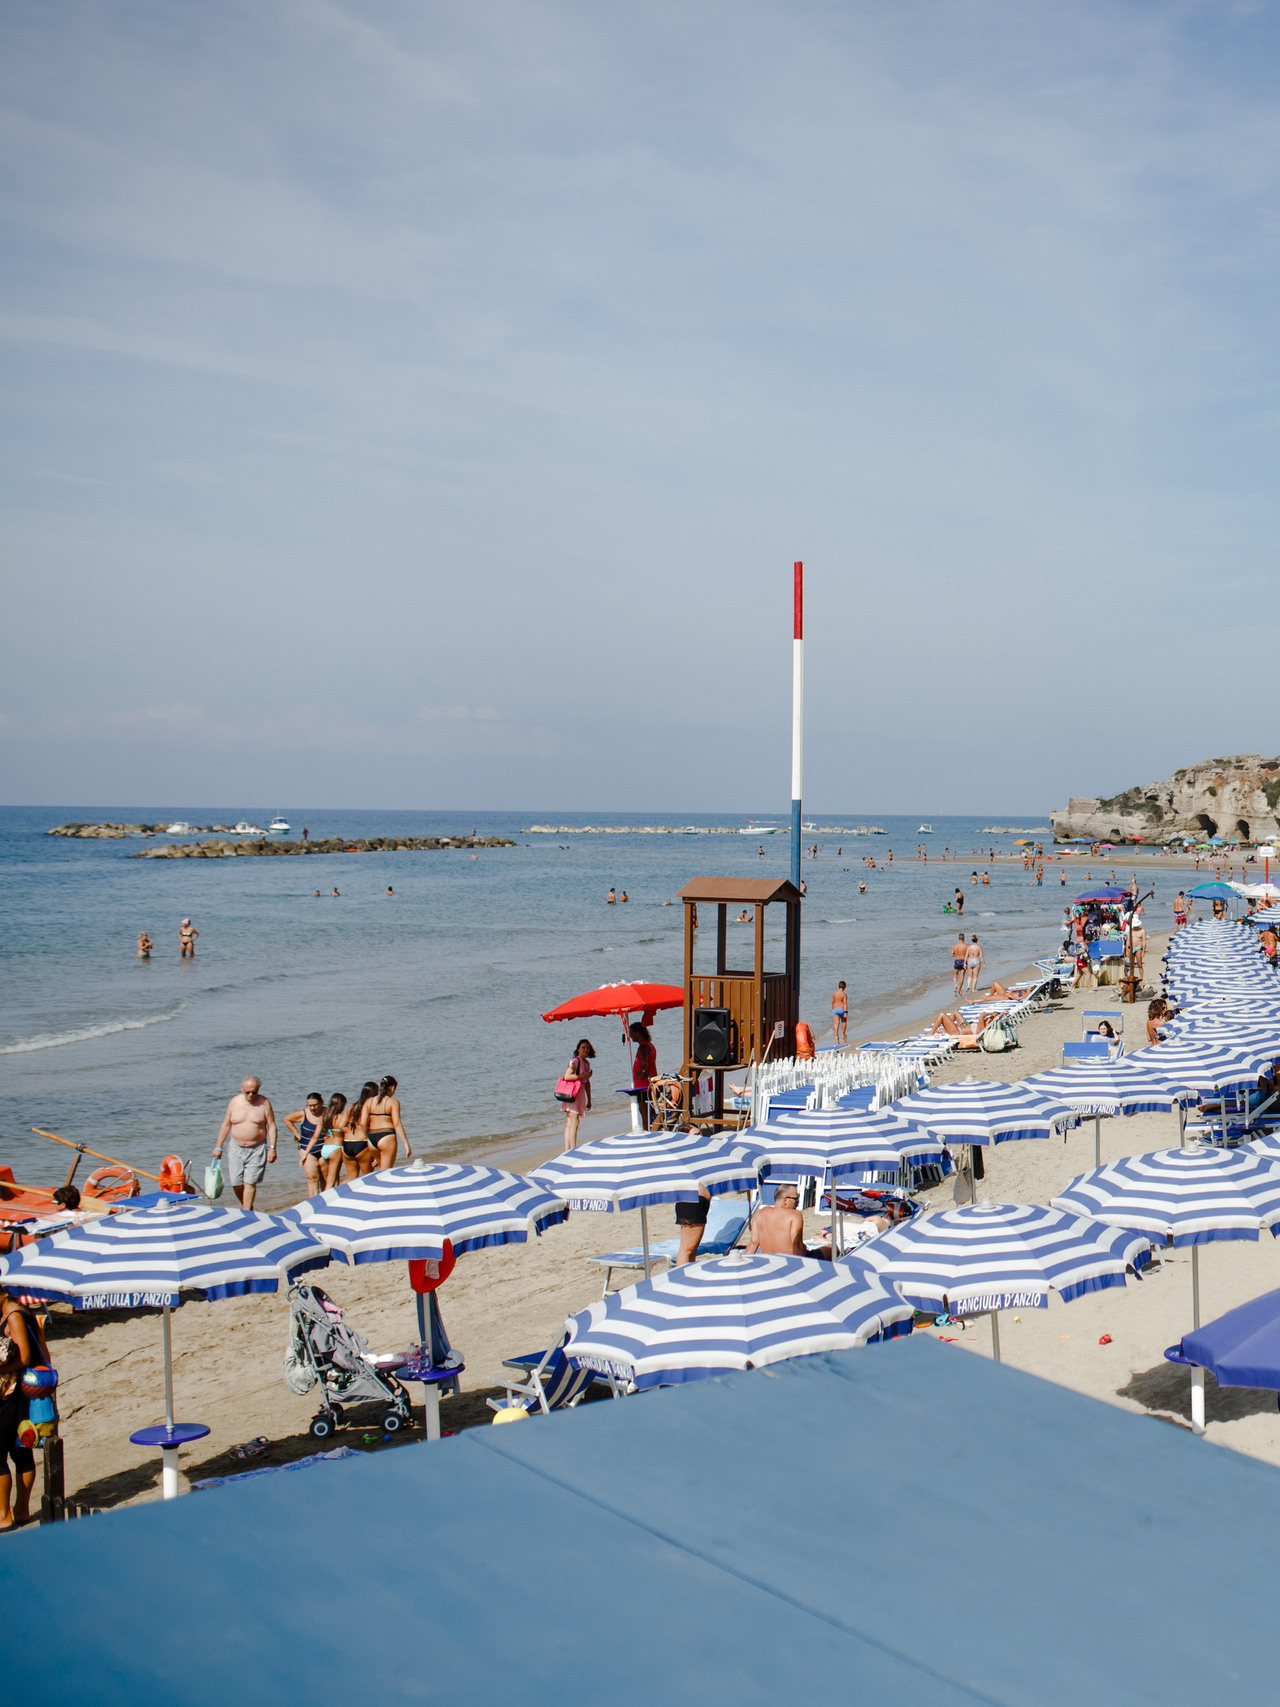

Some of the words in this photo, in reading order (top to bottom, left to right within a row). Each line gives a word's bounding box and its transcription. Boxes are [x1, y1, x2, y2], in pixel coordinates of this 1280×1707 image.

[1093, 1104, 1116, 1115] D'ANZIO
[582, 1198, 608, 1212] D'ANZIO
[81, 1292, 131, 1309] FANCIULLA
[132, 1292, 172, 1306] D'ANZIO
[957, 1294, 1002, 1315] FANCIULLA
[1004, 1292, 1041, 1308] D'ANZIO
